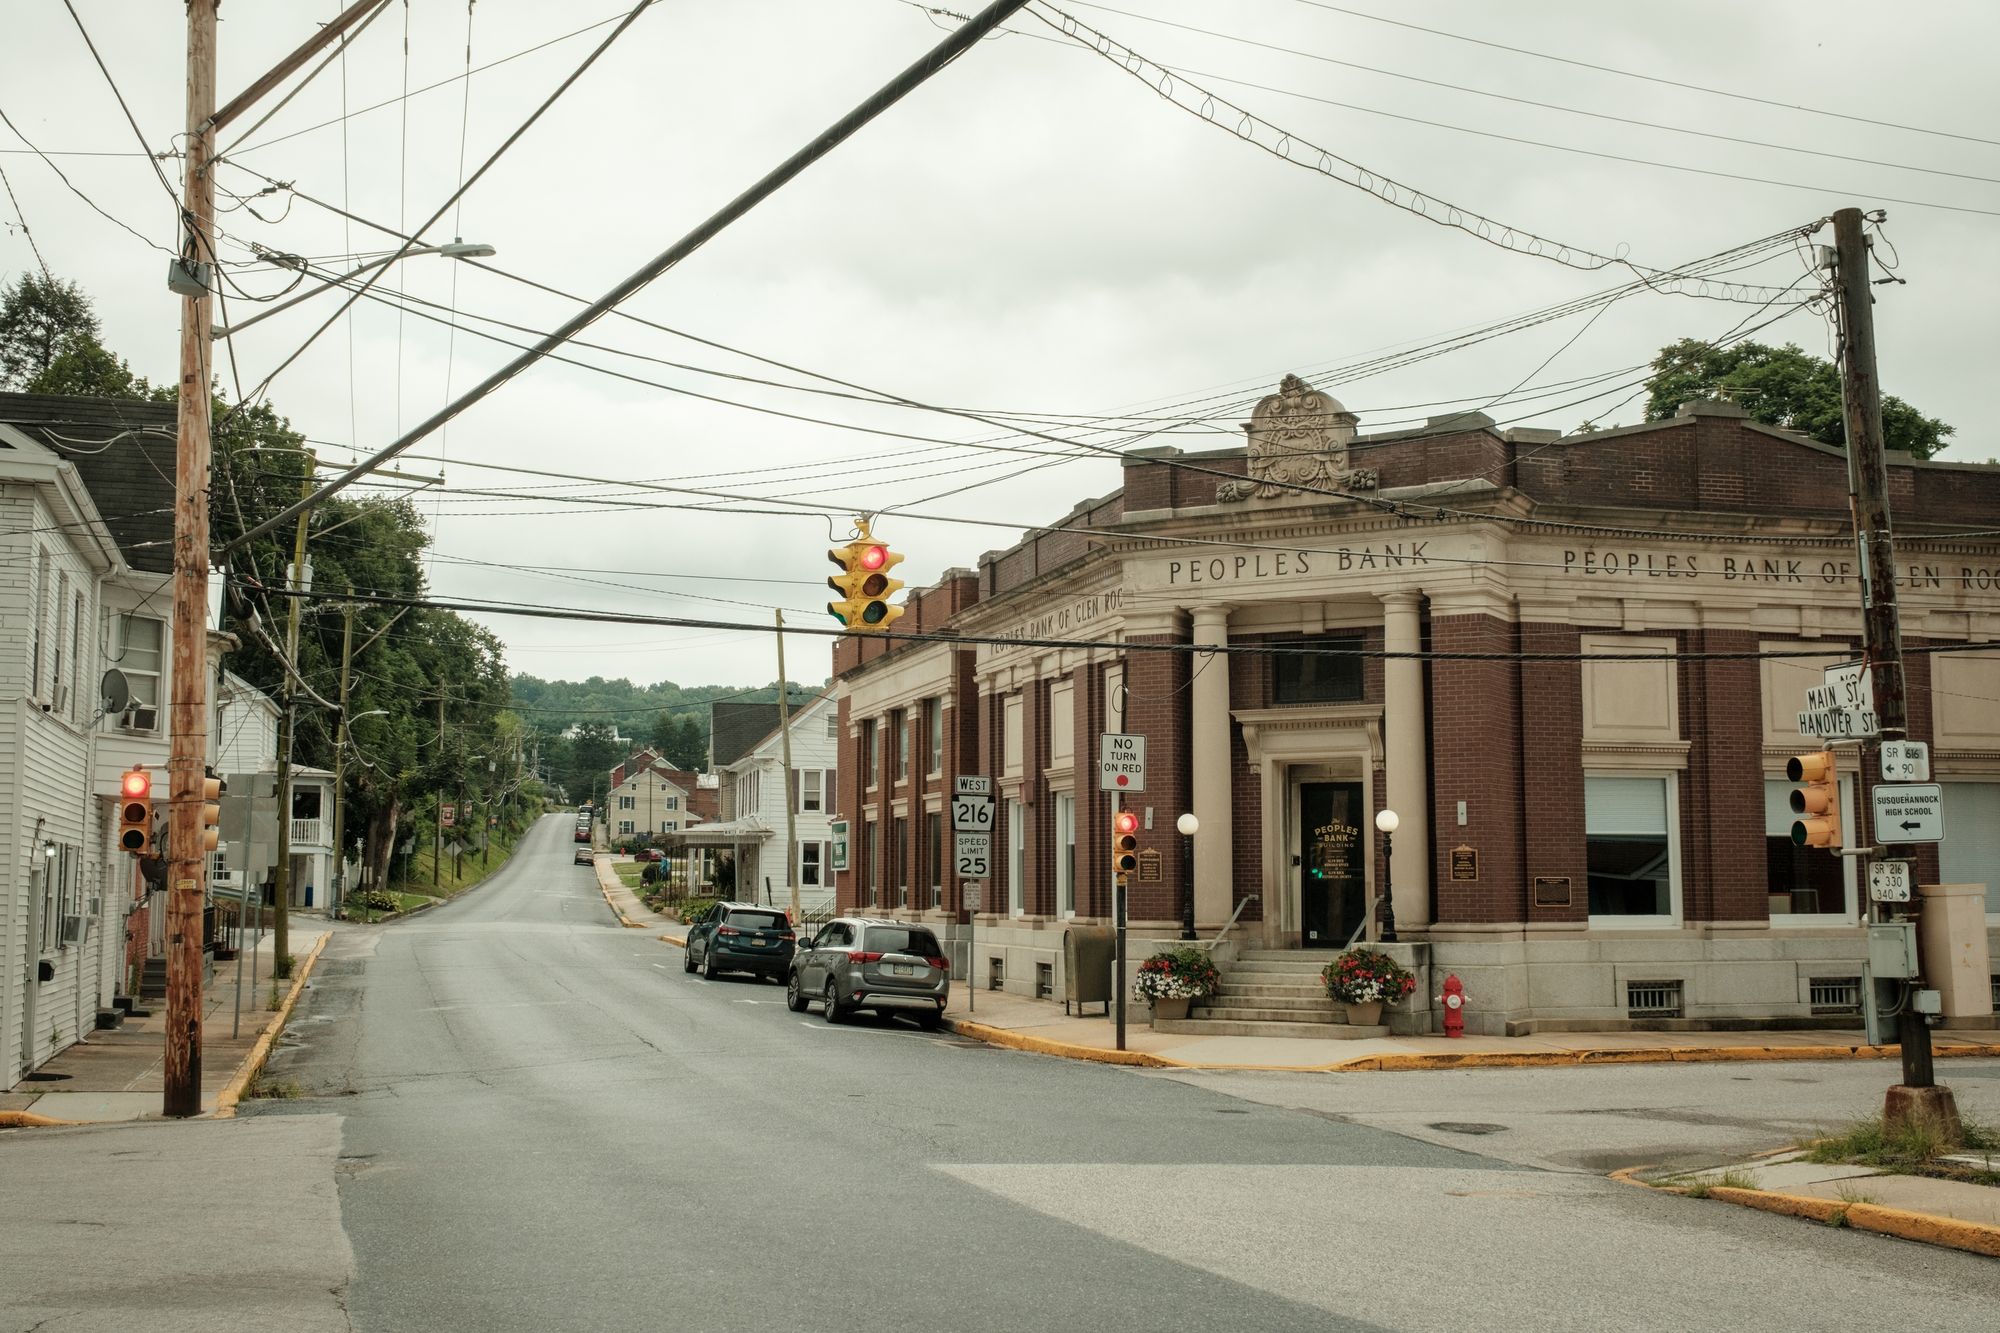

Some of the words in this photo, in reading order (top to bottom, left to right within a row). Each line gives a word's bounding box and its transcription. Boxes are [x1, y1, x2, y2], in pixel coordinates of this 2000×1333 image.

[1169, 551, 1310, 584] PEOPLES
[1338, 541, 1430, 571] BANK
[1564, 549, 1699, 578] PEOPLES
[1723, 557, 1804, 584] BANK
[1821, 561, 1852, 585] OF
[1894, 564, 1941, 589] LEN
[1961, 567, 2000, 590] ROC
[1030, 615, 1054, 640] BANK
[1058, 608, 1070, 630] OF
[1104, 587, 1124, 612] ROC
[1807, 687, 1837, 711] MAIN
[1845, 681, 1860, 703] ST
[1799, 713, 1852, 735] HANOVER
[1862, 712, 1875, 733] ST
[1113, 738, 1133, 750] NO
[1110, 752, 1137, 762] TURN
[1886, 747, 1899, 758] SR
[1905, 748, 1920, 759] 616
[1104, 763, 1119, 772] ON
[1121, 764, 1142, 773] RED
[1901, 763, 1914, 775] 90
[959, 778, 987, 791] WEST
[1876, 795, 1939, 805] SUSQUEHANNOCK
[958, 803, 989, 824] 216
[1885, 808, 1903, 816] HIGH
[1904, 807, 1933, 816] SCHOOL
[1314, 824, 1359, 836] PEOPLES
[958, 837, 988, 845] SPEED
[1324, 834, 1348, 842] BANK
[961, 846, 984, 855] LIMIT
[959, 858, 987, 875] 25
[1874, 864, 1885, 874] SR
[1890, 864, 1903, 875] 216
[1885, 876, 1903, 888] 330
[1877, 889, 1894, 900] 340
